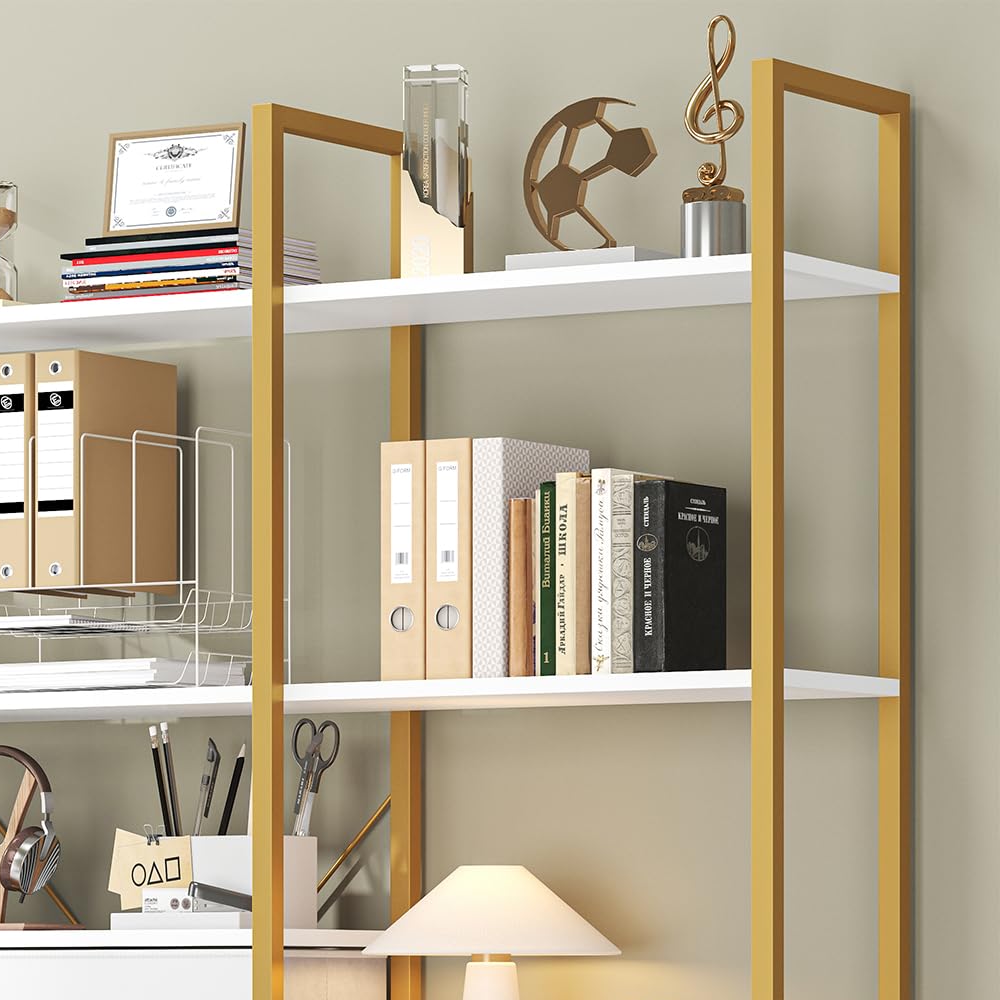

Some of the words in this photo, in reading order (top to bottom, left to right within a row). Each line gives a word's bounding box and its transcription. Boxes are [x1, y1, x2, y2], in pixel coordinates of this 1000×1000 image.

[156, 162, 192, 171] CERTIFICATE
[542, 490, 551, 534] Бианки
[558, 504, 568, 556] ШКОЛА
[678, 512, 697, 522] КРАСНОЕ
[702, 515, 719, 525] ЧЕРНОЕ
[542, 536, 551, 588] Виталий
[643, 557, 652, 589] ЧЕРНОЕ
[594, 608, 608, 652] Сказки
[644, 600, 653, 636] КРАСНОЕ
